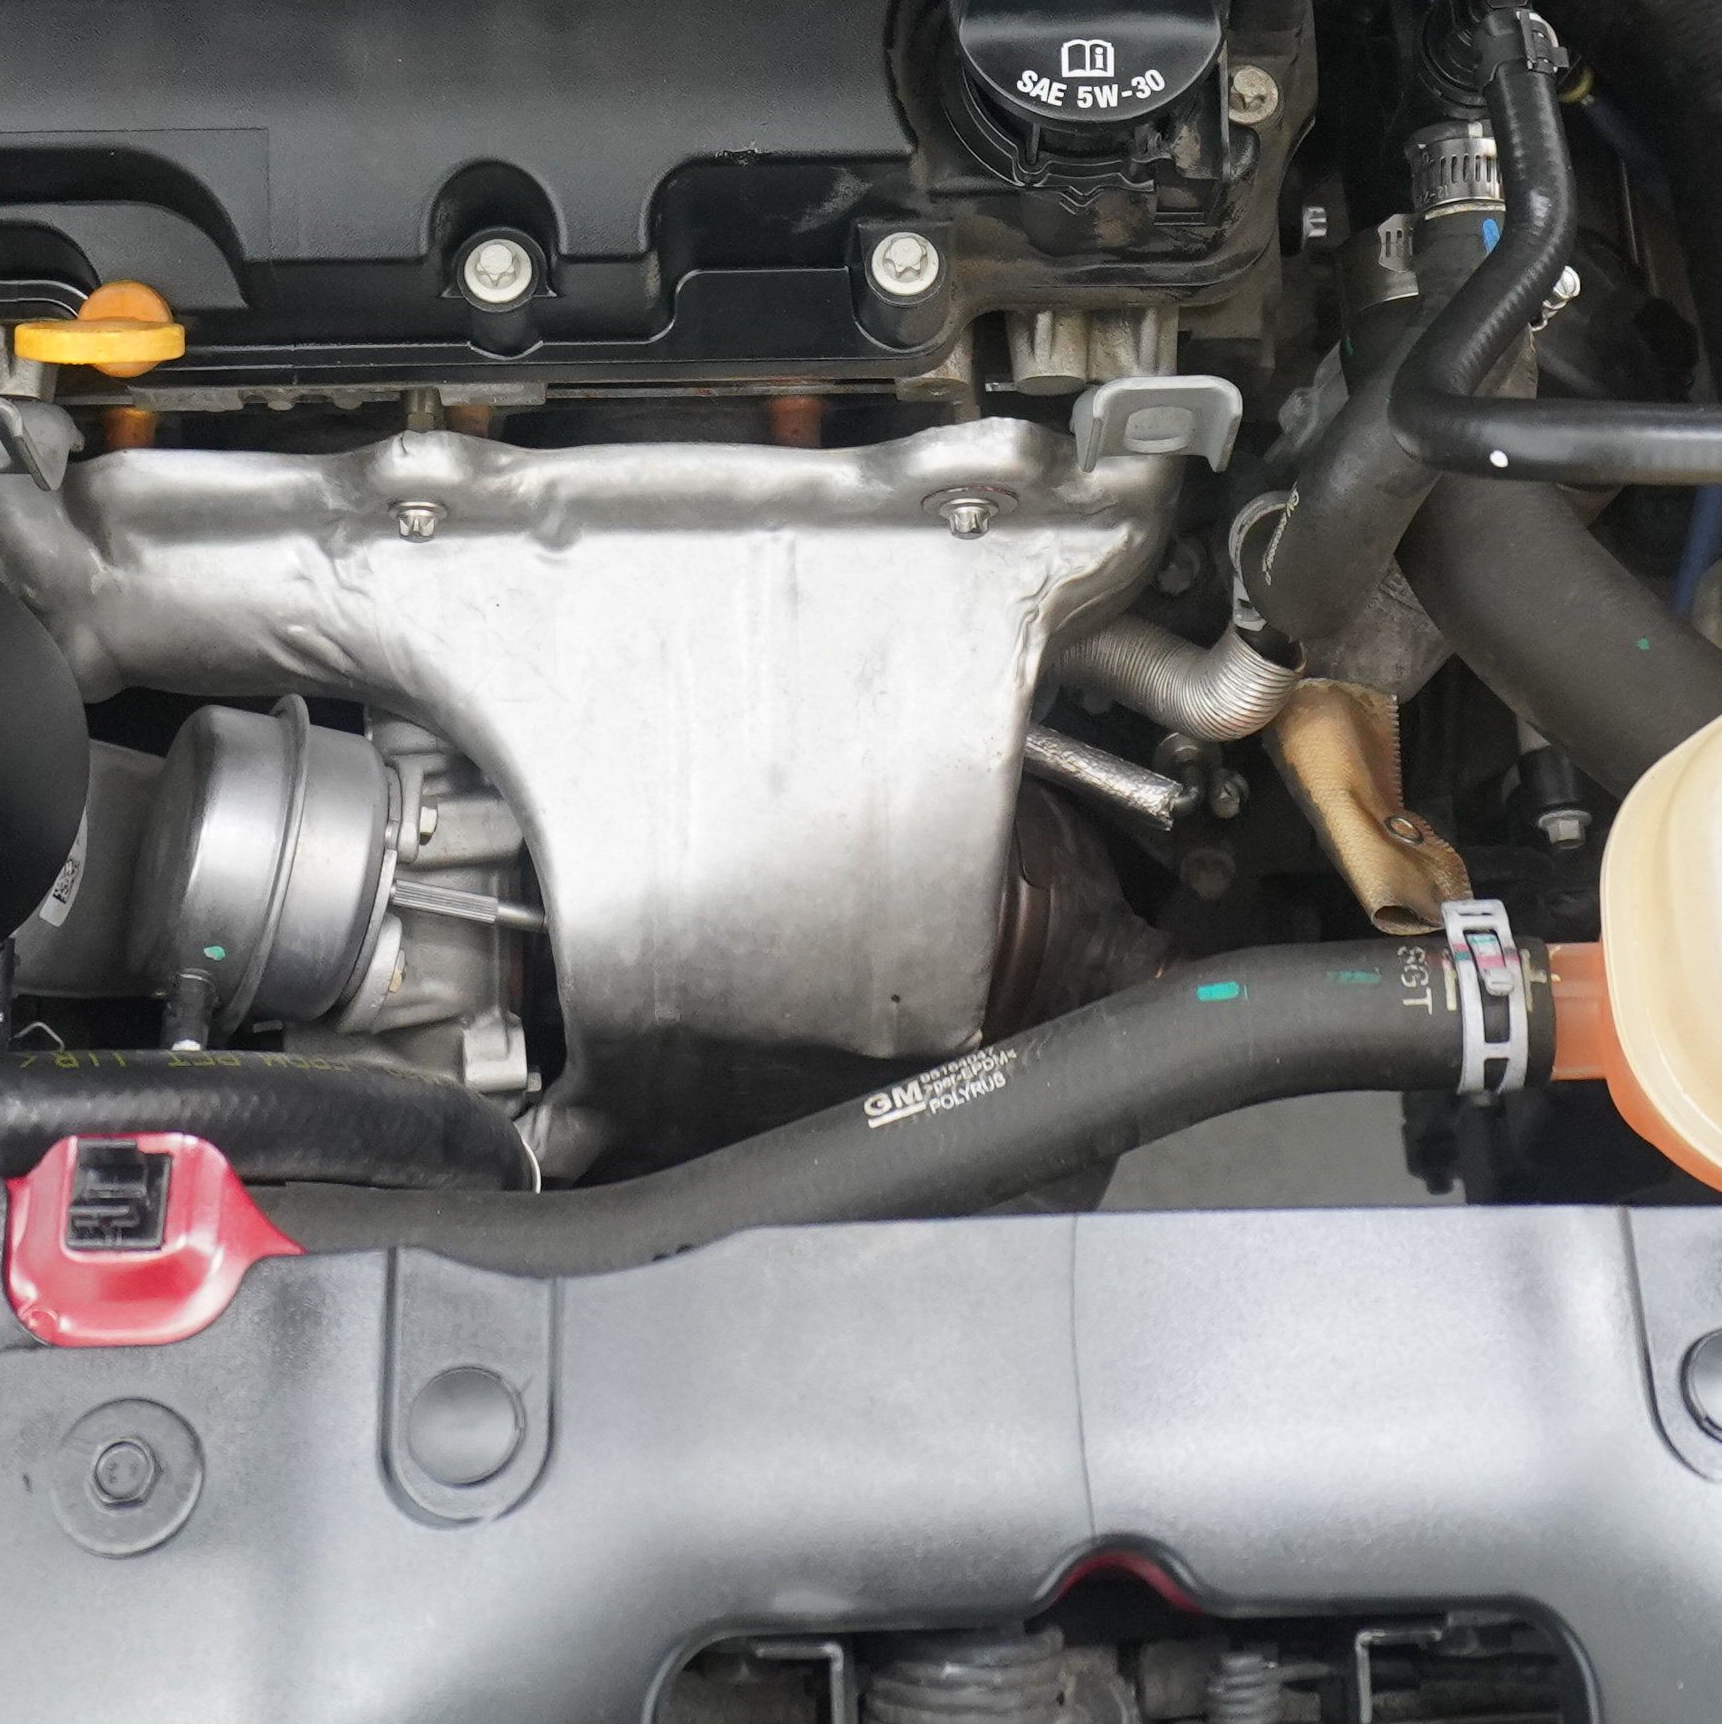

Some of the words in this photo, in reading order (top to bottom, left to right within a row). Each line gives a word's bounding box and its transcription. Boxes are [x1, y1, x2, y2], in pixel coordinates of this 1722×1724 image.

[1017, 70, 1067, 106] SAE
[1077, 69, 1165, 108] 5W-30
[864, 1079, 924, 1116] GM
[929, 1071, 1007, 1115] POLYRUB
